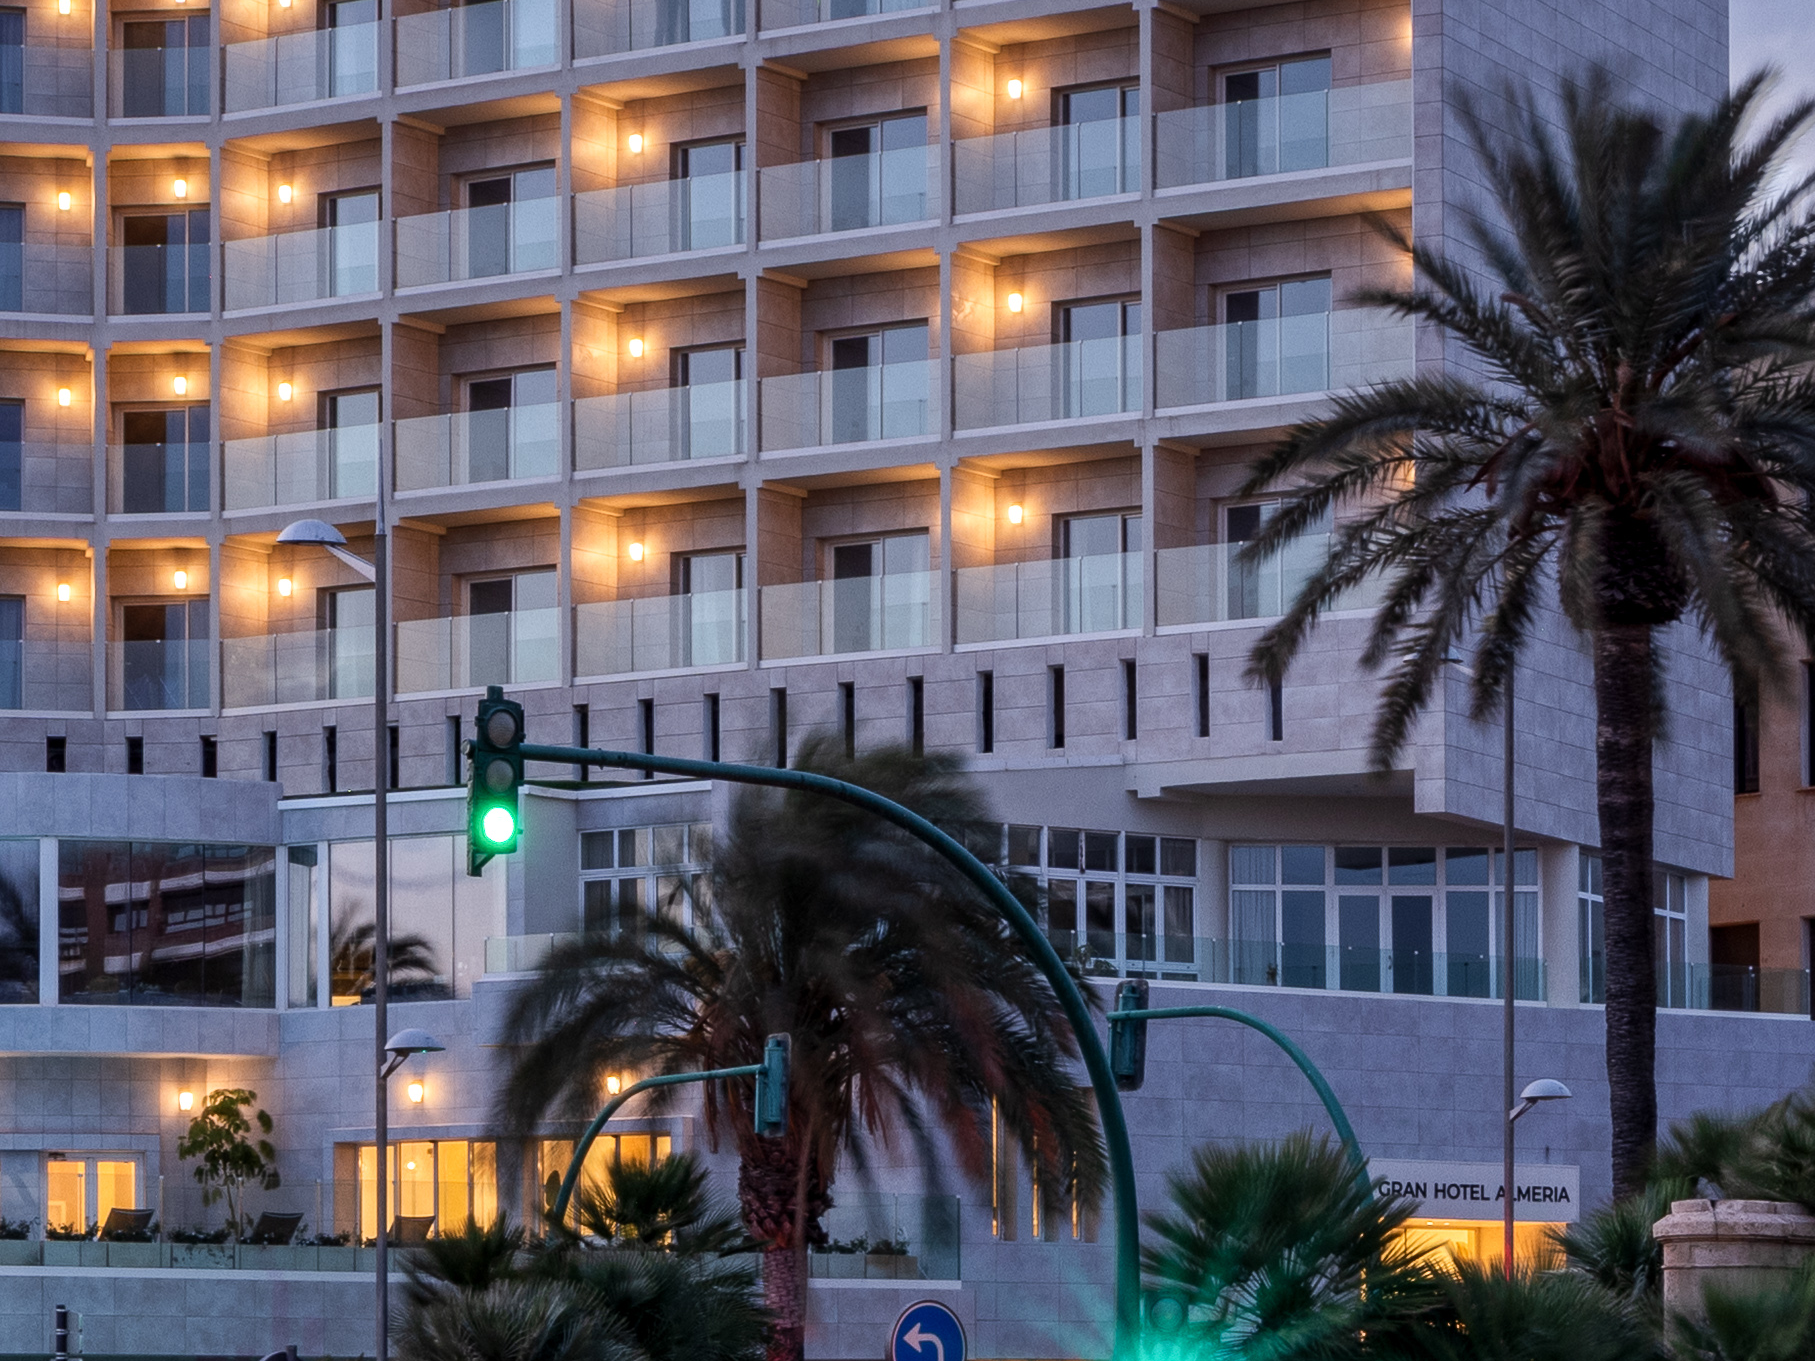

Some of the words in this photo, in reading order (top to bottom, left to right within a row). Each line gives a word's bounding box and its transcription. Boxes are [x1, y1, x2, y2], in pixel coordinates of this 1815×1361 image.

[1378, 1180, 1428, 1199] GRAN
[1434, 1182, 1490, 1201] HOTEL
[1495, 1184, 1571, 1203] AMERIA
